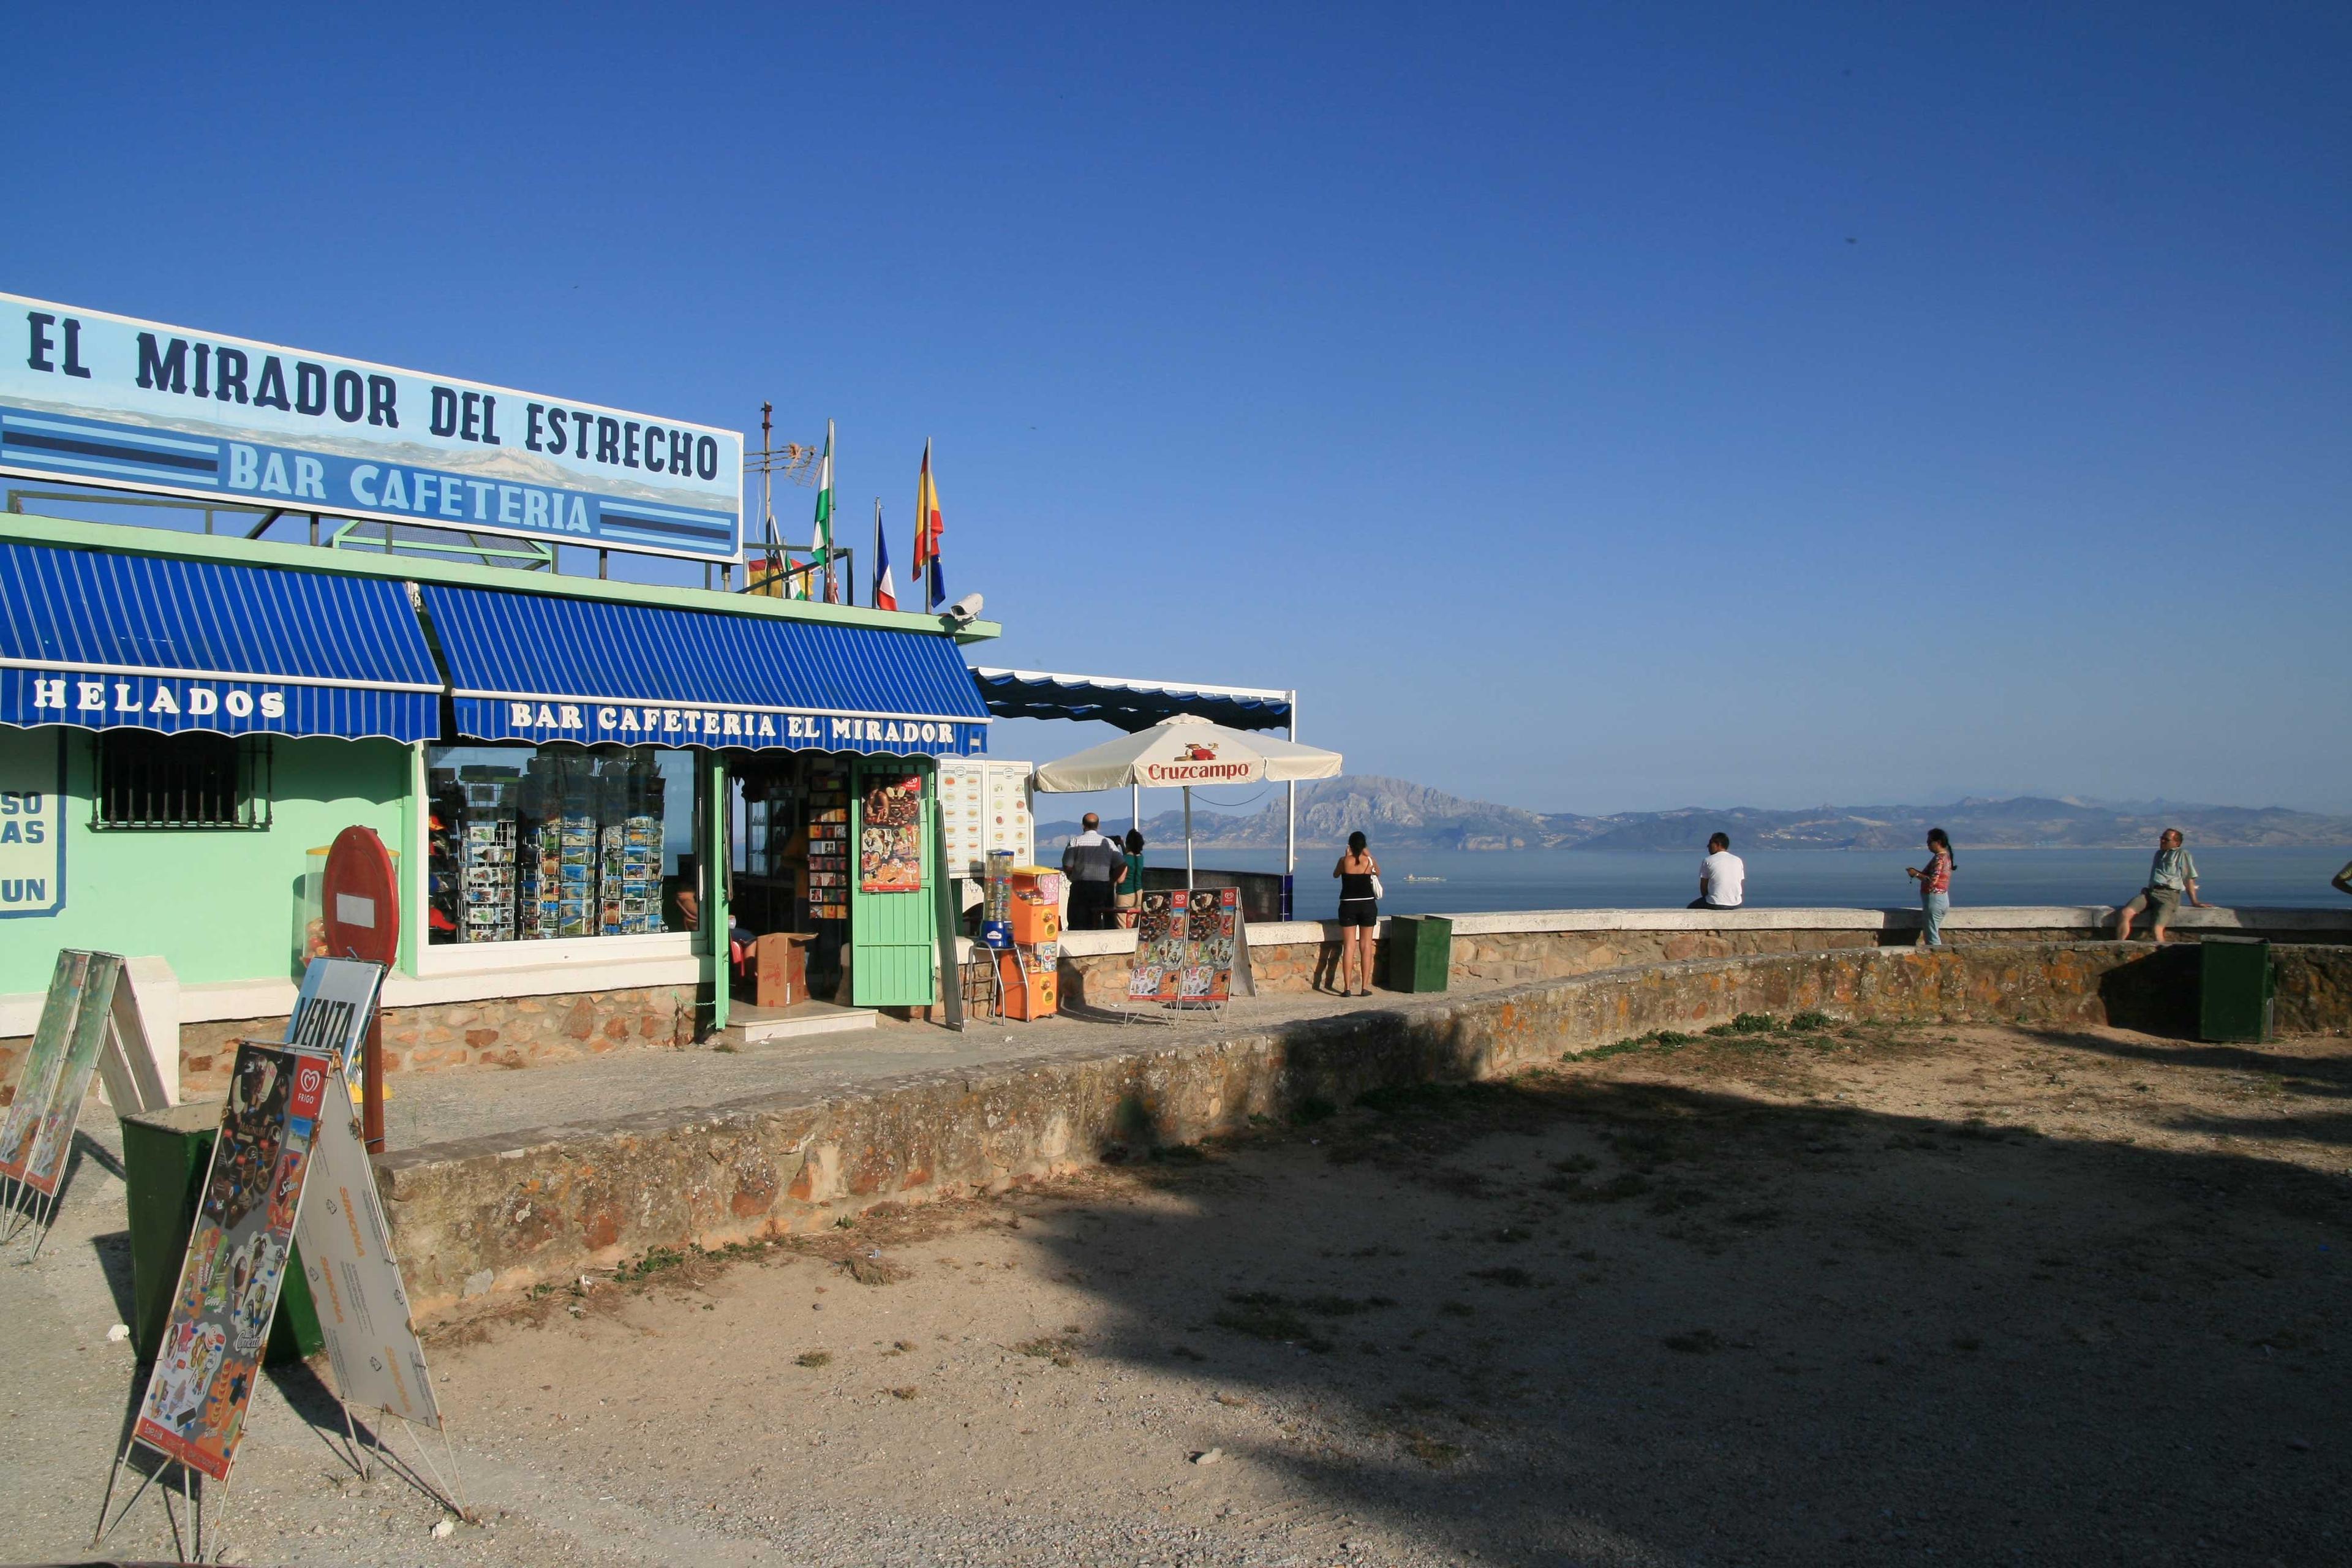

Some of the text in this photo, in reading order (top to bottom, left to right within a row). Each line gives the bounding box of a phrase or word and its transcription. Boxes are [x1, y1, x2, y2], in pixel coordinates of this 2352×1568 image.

[26, 311, 718, 481] EL MIRADOR DEL ESTRECHO
[228, 442, 591, 534] BAR CAFETERIA
[34, 678, 286, 718] HELADOS
[511, 703, 954, 744] BAR CAFETERIA EL MIRADOR
[1148, 763, 1250, 780] Cruzcampo
[0, 791, 42, 815] SO
[0, 820, 45, 845] AS
[1, 878, 46, 903] UN
[291, 997, 356, 1056] VENTA
[298, 1093, 314, 1104] FRIGO
[339, 1186, 366, 1258] SIMONA
[320, 1255, 345, 1325] SIMONA
[385, 1344, 412, 1413] SIMONA
